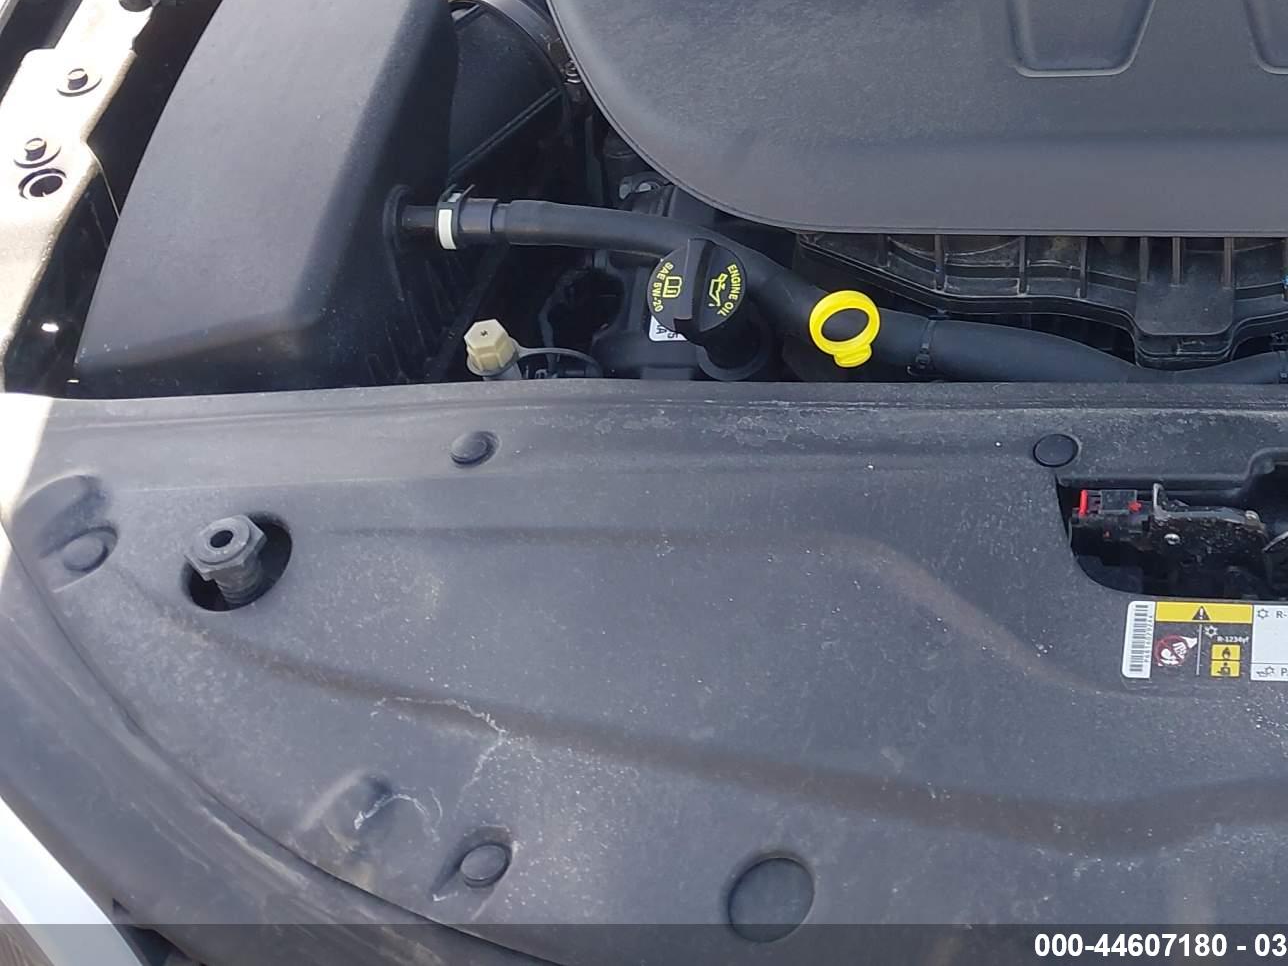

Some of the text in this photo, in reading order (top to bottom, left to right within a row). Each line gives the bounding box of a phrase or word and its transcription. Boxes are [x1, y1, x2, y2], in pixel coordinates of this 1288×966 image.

[652, 262, 674, 312] SAE 5W-20
[717, 264, 741, 316] ENGINE OIL
